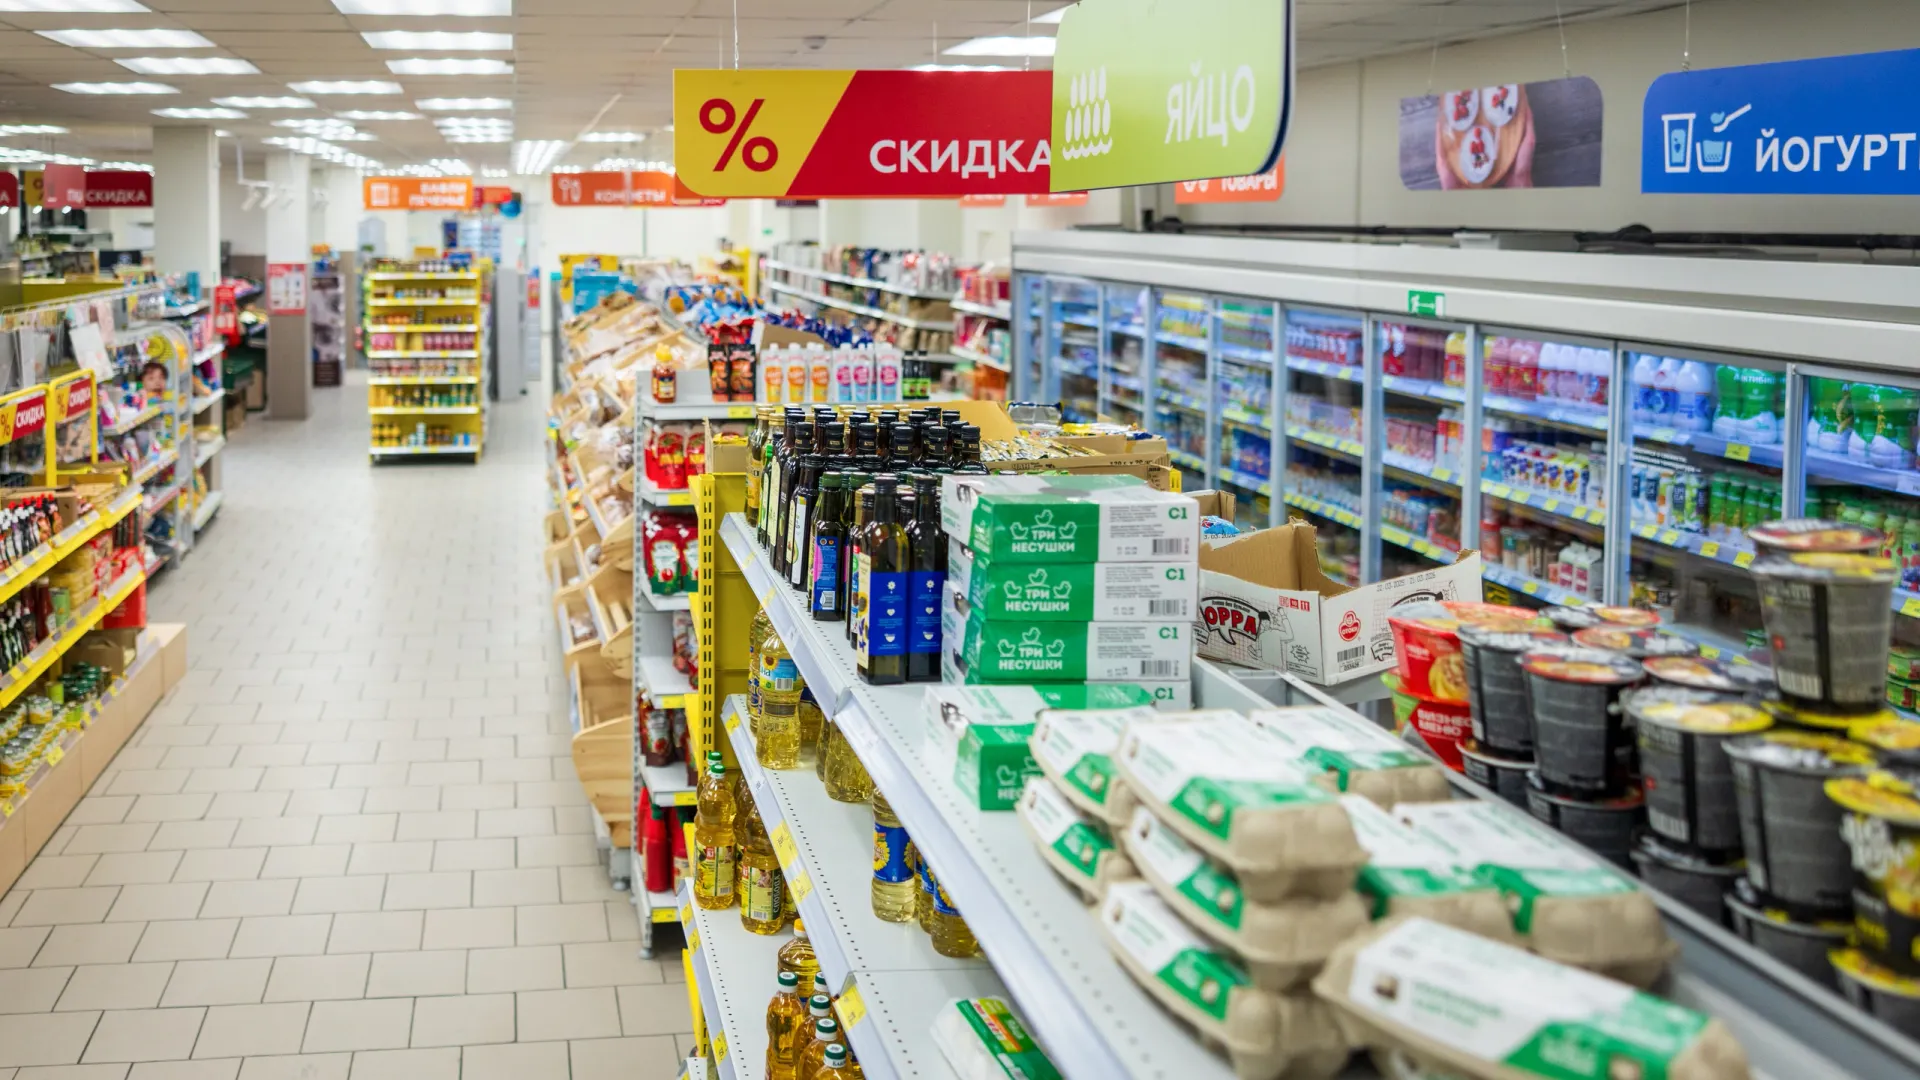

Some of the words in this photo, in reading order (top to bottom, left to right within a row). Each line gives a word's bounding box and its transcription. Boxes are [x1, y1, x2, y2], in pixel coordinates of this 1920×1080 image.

[1165, 61, 1256, 147] ЯЙЦО
[699, 98, 779, 172] %
[869, 138, 1052, 180] СКИДКА
[1755, 128, 1920, 173] ЙОГУРТ
[86, 189, 147, 204] СКИДКА
[16, 403, 46, 428] СКИДКА
[1031, 529, 1056, 541] ТРИ
[1012, 542, 1075, 553] НЕСУШКИ
[1025, 589, 1050, 600] ТРИ
[1005, 601, 1070, 612] НЕСУШКИ
[1204, 606, 1258, 636] OPPA
[1018, 647, 1043, 658] ТРИ
[999, 660, 1063, 670] НЕСУШКИ
